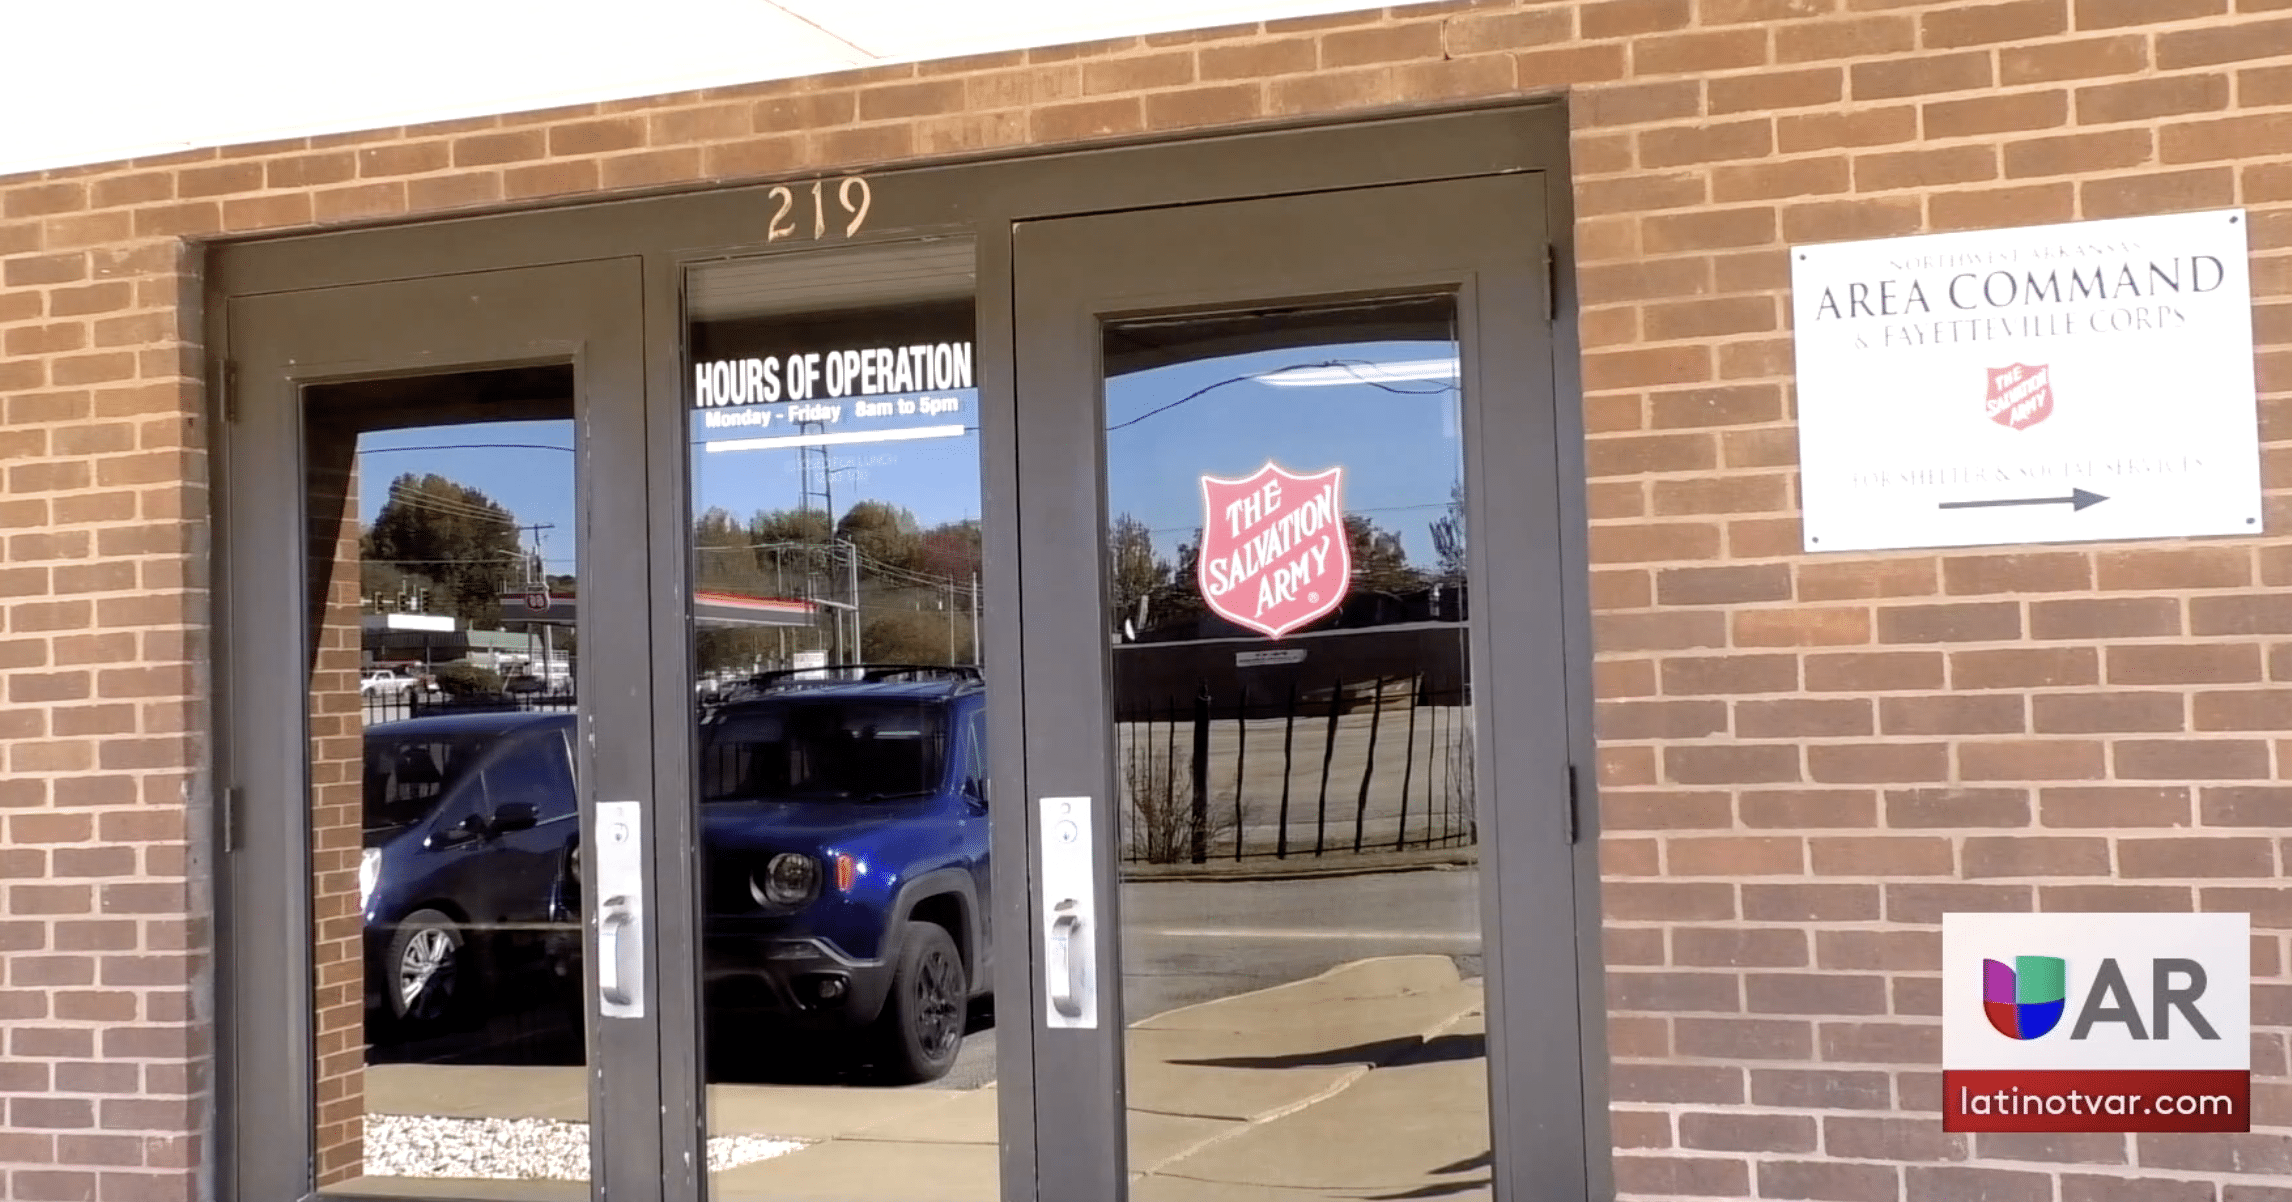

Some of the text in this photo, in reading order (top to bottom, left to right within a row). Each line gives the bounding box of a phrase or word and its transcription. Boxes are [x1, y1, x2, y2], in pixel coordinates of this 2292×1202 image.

[767, 177, 871, 242] 219
[1816, 255, 2224, 320] AREA COMMAND
[1885, 312, 2077, 347] FAYETTEVILLE
[2089, 306, 2186, 333] CORPS
[695, 342, 972, 407] HOURS OF OPERATION
[1995, 367, 2023, 391] THE
[705, 409, 771, 428] Monday
[788, 404, 841, 424] Friday
[855, 400, 893, 418] 8am
[897, 398, 915, 414] to
[919, 396, 959, 416] 5pm
[2009, 389, 2045, 427] ARMY
[1209, 484, 1332, 596] SALVATION
[1226, 478, 1282, 539] THE
[1254, 535, 1330, 618] ARMY
